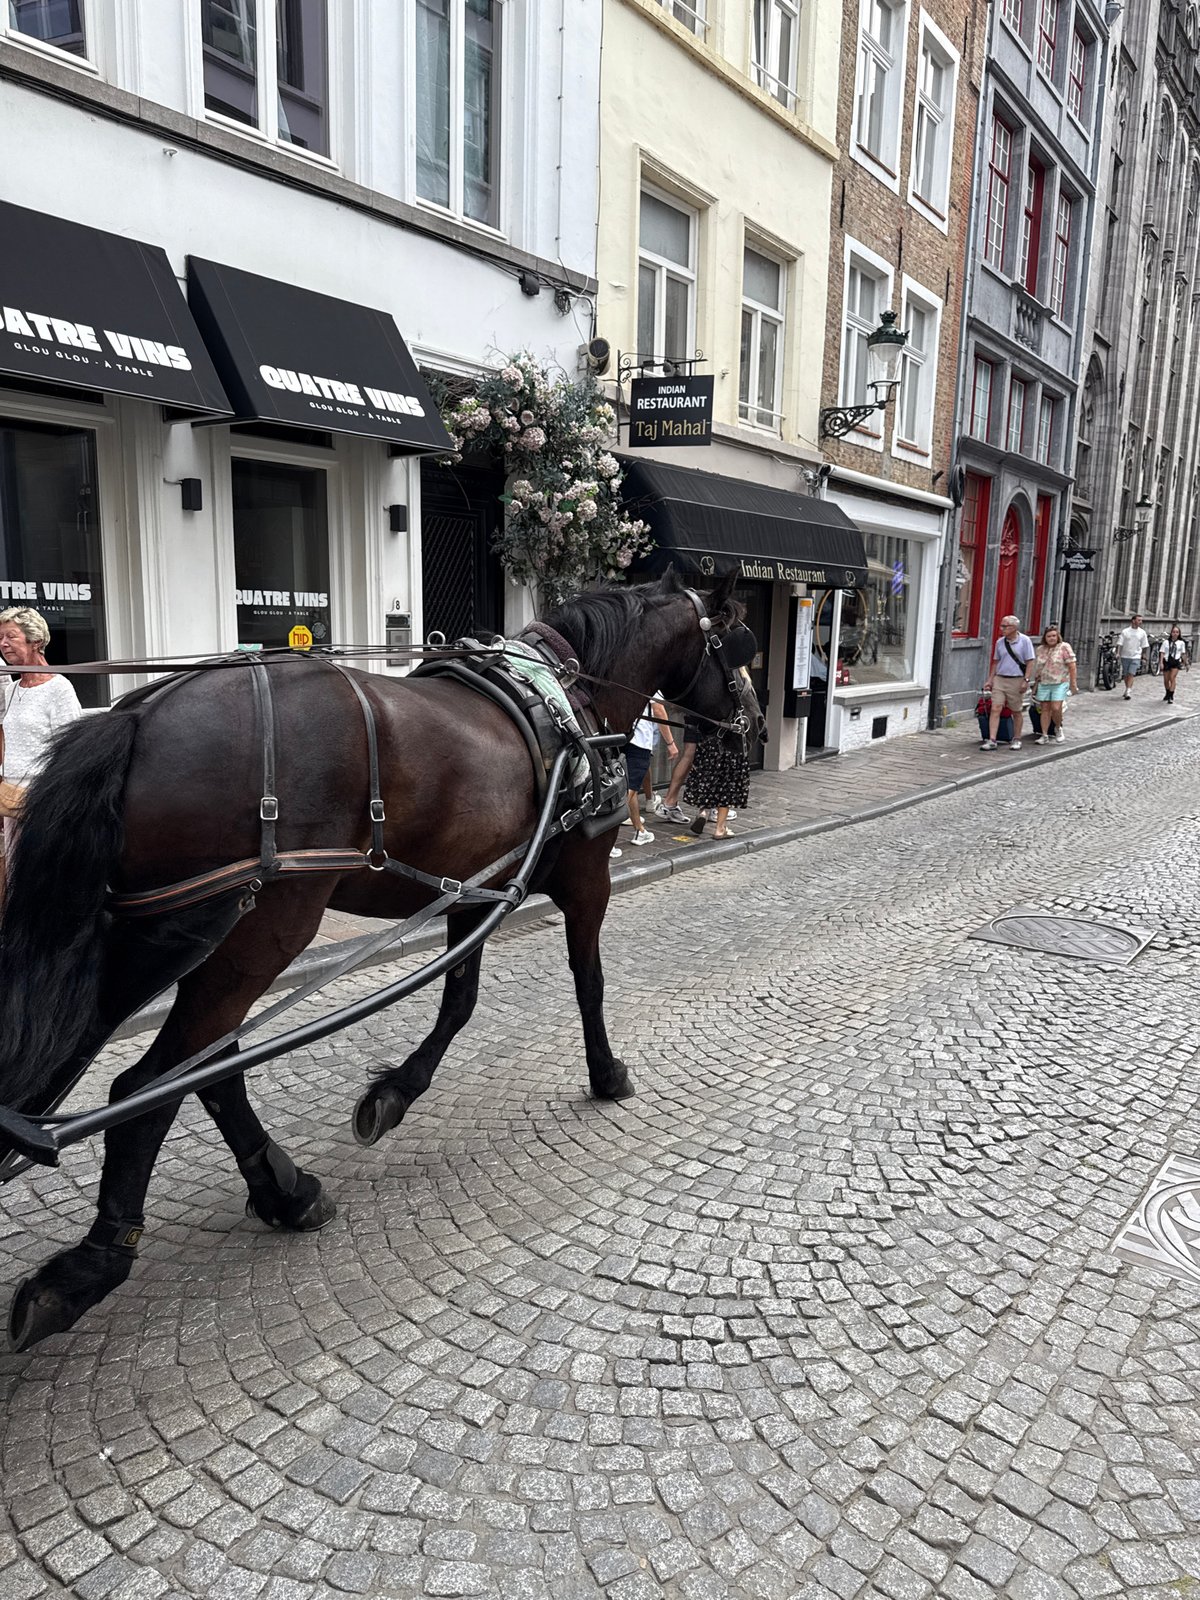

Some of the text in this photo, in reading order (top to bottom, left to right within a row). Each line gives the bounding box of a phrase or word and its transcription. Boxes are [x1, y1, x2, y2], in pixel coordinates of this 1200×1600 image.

[0, 306, 192, 371] ATRE VINS
[14, 342, 50, 356] GLOU
[55, 351, 90, 364] GLOU
[116, 363, 154, 378] TABLE
[259, 364, 425, 418] QUATRE VINS
[658, 385, 686, 395] INDIAN
[309, 402, 333, 412] GLOU
[336, 406, 359, 417] GLOU
[376, 414, 402, 425] TABLE
[637, 396, 707, 410] RESTAURANT
[635, 419, 706, 441] Taj Mahal
[740, 559, 826, 583] Indian Restaurant
[42, 582, 92, 601] VINS
[235, 589, 328, 608] QUATRE VINS
[395, 600, 401, 610] 8
